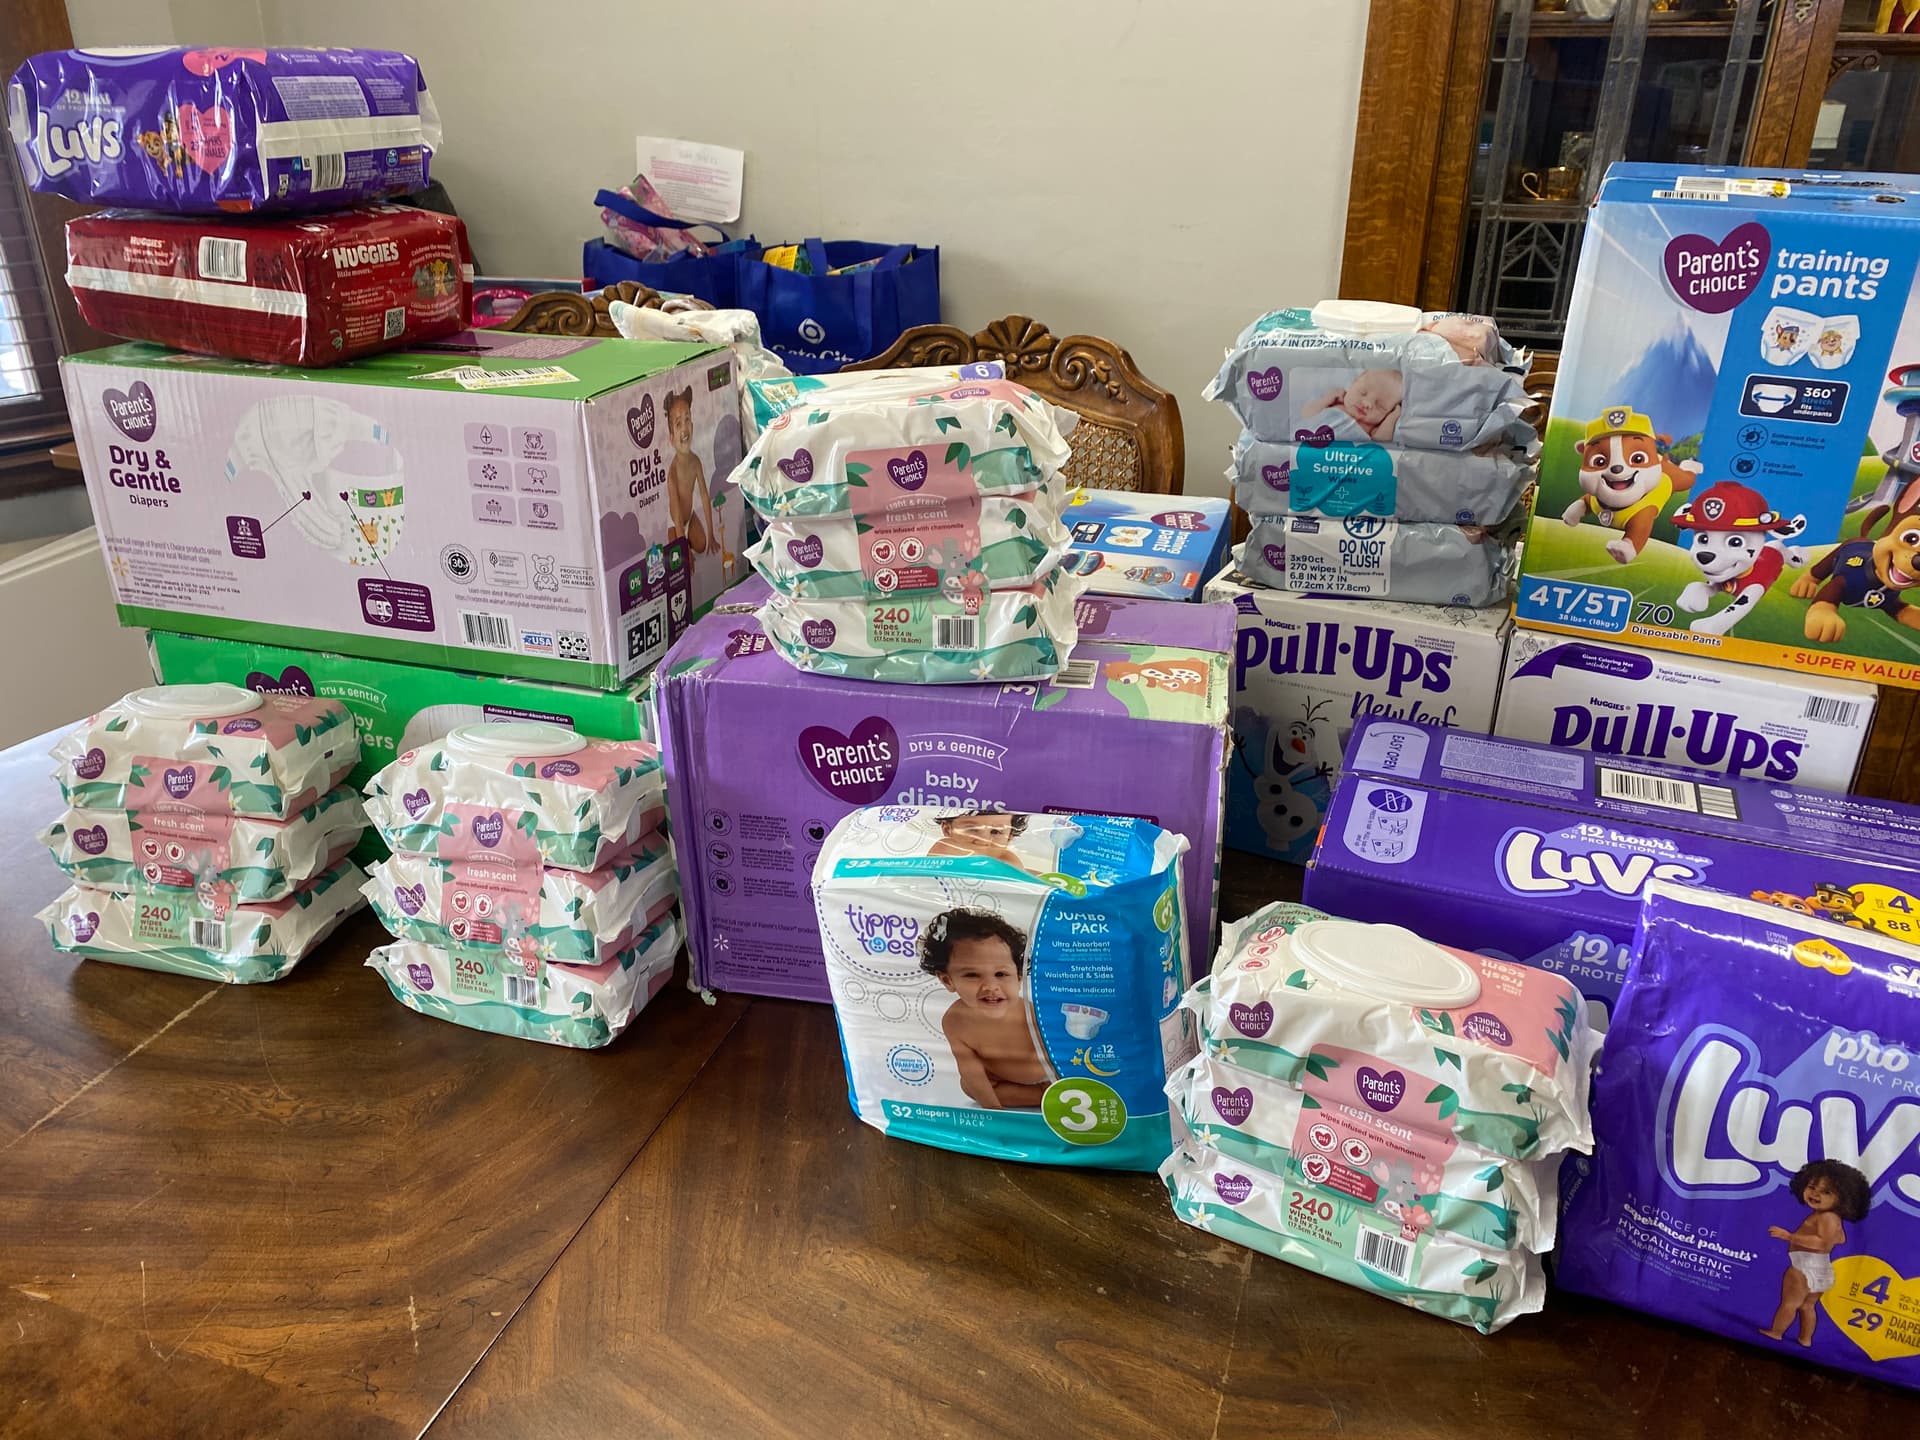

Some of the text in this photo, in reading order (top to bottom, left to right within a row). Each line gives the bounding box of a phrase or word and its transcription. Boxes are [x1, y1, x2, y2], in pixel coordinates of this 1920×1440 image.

[38, 111, 121, 177] Luvs
[130, 236, 165, 249] HUGGIES
[333, 242, 399, 269] HUGGIES
[1678, 241, 1760, 278] Parent's
[1777, 248, 1890, 278] training
[1690, 272, 1747, 296] CHOICE
[1771, 274, 1880, 301] pants
[975, 365, 990, 378] 6
[110, 392, 152, 416] Parent's
[630, 404, 654, 432] Parent's
[1793, 409, 1832, 417] underpants
[122, 416, 152, 430] CHOICE
[109, 446, 172, 472] Dry &
[630, 450, 662, 478] Dry &
[1324, 450, 1362, 462] Ultra-
[892, 457, 925, 476] Parent's
[1314, 463, 1374, 476] Sensitive
[110, 469, 182, 494] Gentle
[629, 468, 666, 498] Gentle
[900, 474, 923, 484] CHOICE
[129, 494, 169, 508] Diapers
[639, 492, 660, 508] Diapers
[886, 510, 948, 522] fresh scent
[1152, 528, 1176, 552] pants
[1167, 530, 1192, 555] training
[1339, 540, 1386, 556] DO NOT
[792, 541, 820, 557] Parent's
[1290, 554, 1324, 564] 3x90ct
[1343, 554, 1380, 568] FLUSH
[1290, 563, 1337, 574] 270 wipes
[1290, 572, 1348, 582] 6.8 IN IN
[1290, 580, 1371, 592] (17.2cm 17.8cm)
[1529, 584, 1628, 620] 4T/5T
[873, 608, 910, 624] 240
[1636, 601, 1674, 625] 70
[806, 624, 834, 638] Parent's
[874, 623, 898, 631] wipes
[1264, 618, 1296, 631] HUGGIES
[1588, 616, 1620, 630] (18kg+)
[810, 634, 832, 644] CHOICE
[1631, 624, 1723, 648] Disposable Pants
[1582, 653, 1597, 661] Giant
[1598, 655, 1622, 667] Coloring
[1795, 652, 1856, 672] SUPER
[320, 687, 380, 704] Dry Gentle
[1590, 696, 1625, 711] HUGGIES
[488, 706, 512, 714] Advanced
[812, 734, 892, 768] Parent's
[909, 741, 996, 760] Dry & Gentle
[1391, 735, 1406, 752] EASY
[1382, 735, 1406, 770] EASY OPEN
[74, 754, 103, 770] Parent's
[167, 772, 193, 786] Parent's
[831, 766, 885, 786] CHOICE
[925, 770, 979, 794] baby
[171, 784, 190, 792] CHOICE
[1794, 793, 1894, 814] VISIT LUVS.COM
[154, 816, 206, 832] fresh scent
[1106, 818, 1134, 829] PACK
[1800, 806, 1886, 826] MONEY BACK
[476, 819, 502, 833] Parent's
[77, 832, 106, 846] Parent's
[480, 832, 499, 840] CHOICE
[1577, 824, 1676, 852] 12 hours
[1580, 836, 1656, 854] PROTECTION
[467, 866, 516, 882] fresh scent
[141, 905, 172, 921] 240
[1888, 896, 1914, 914] 4
[844, 904, 919, 940] tippy
[1055, 911, 1106, 922] JUMBO
[1071, 922, 1110, 935] PACK
[1888, 919, 1912, 932] 88
[858, 932, 916, 958] toes
[1052, 940, 1110, 948] Ultra Absorbent
[1570, 935, 1616, 963] 12
[455, 958, 484, 974] 240
[1542, 958, 1565, 970] OF
[456, 972, 477, 980] wipes
[1044, 972, 1114, 980] Waistband Sides
[1482, 968, 1524, 988] fresh
[1050, 986, 1082, 994] Wetness
[1233, 1008, 1270, 1023] Parent's
[1474, 1016, 1501, 1029] CHOICE
[1240, 1020, 1266, 1030] CHOICE
[1102, 1044, 1114, 1054] 12
[1824, 1030, 1910, 1073] pro
[1837, 1062, 1883, 1086] LEAK
[1362, 1074, 1401, 1094] Parent's
[1215, 1094, 1250, 1108] Parent's
[1366, 1092, 1395, 1105] CHOICE
[890, 1104, 950, 1119] 32 diapers
[960, 1111, 993, 1121] JUMBO
[1059, 1089, 1098, 1132] 3
[1222, 1106, 1246, 1117] CHOICE
[960, 1118, 985, 1128] PACK
[1375, 1117, 1414, 1142] scent
[1320, 1112, 1426, 1160] wipes infused with chamomile
[1222, 1188, 1246, 1200] CHOICE
[1290, 1192, 1334, 1221] 240
[1289, 1208, 1318, 1226] wipes
[1623, 1202, 1696, 1245] experienced
[1642, 1204, 1718, 1239] CHOICE OF
[1618, 1218, 1733, 1274] HYPOALLERGENIC
[1628, 1236, 1722, 1280] PARABENS AND LATEX
[1849, 1282, 1861, 1298] SIZE
[1862, 1275, 1892, 1305] 4
[1847, 1308, 1884, 1332] 29
